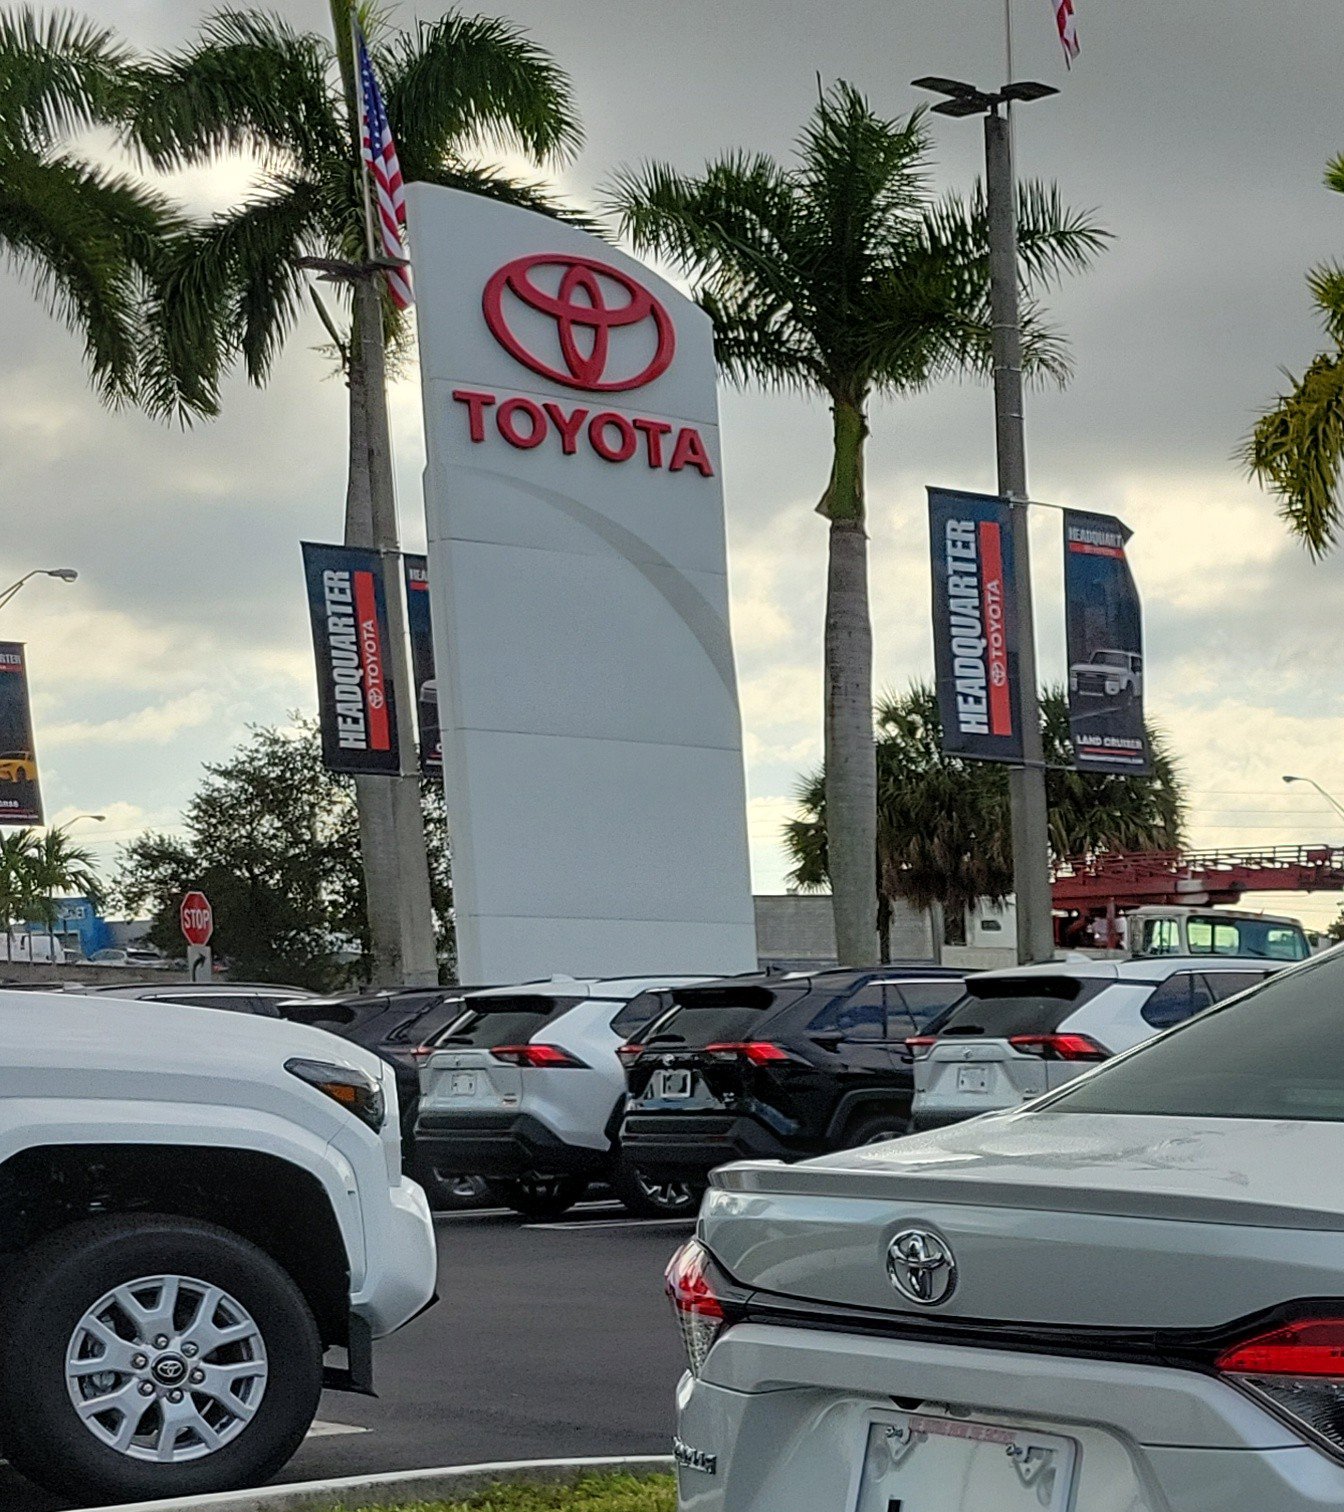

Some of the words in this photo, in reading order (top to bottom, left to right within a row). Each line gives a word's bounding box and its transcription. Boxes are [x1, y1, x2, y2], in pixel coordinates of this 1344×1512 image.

[452, 389, 714, 477] TOYOTA
[362, 619, 380, 686] TOYOTA
[946, 517, 990, 735] HEADQUARTER
[986, 579, 1003, 659] TOYOTA
[323, 569, 367, 750] HEADQUARTER
[1076, 734, 1103, 747] LAND
[184, 909, 210, 930] STOP
